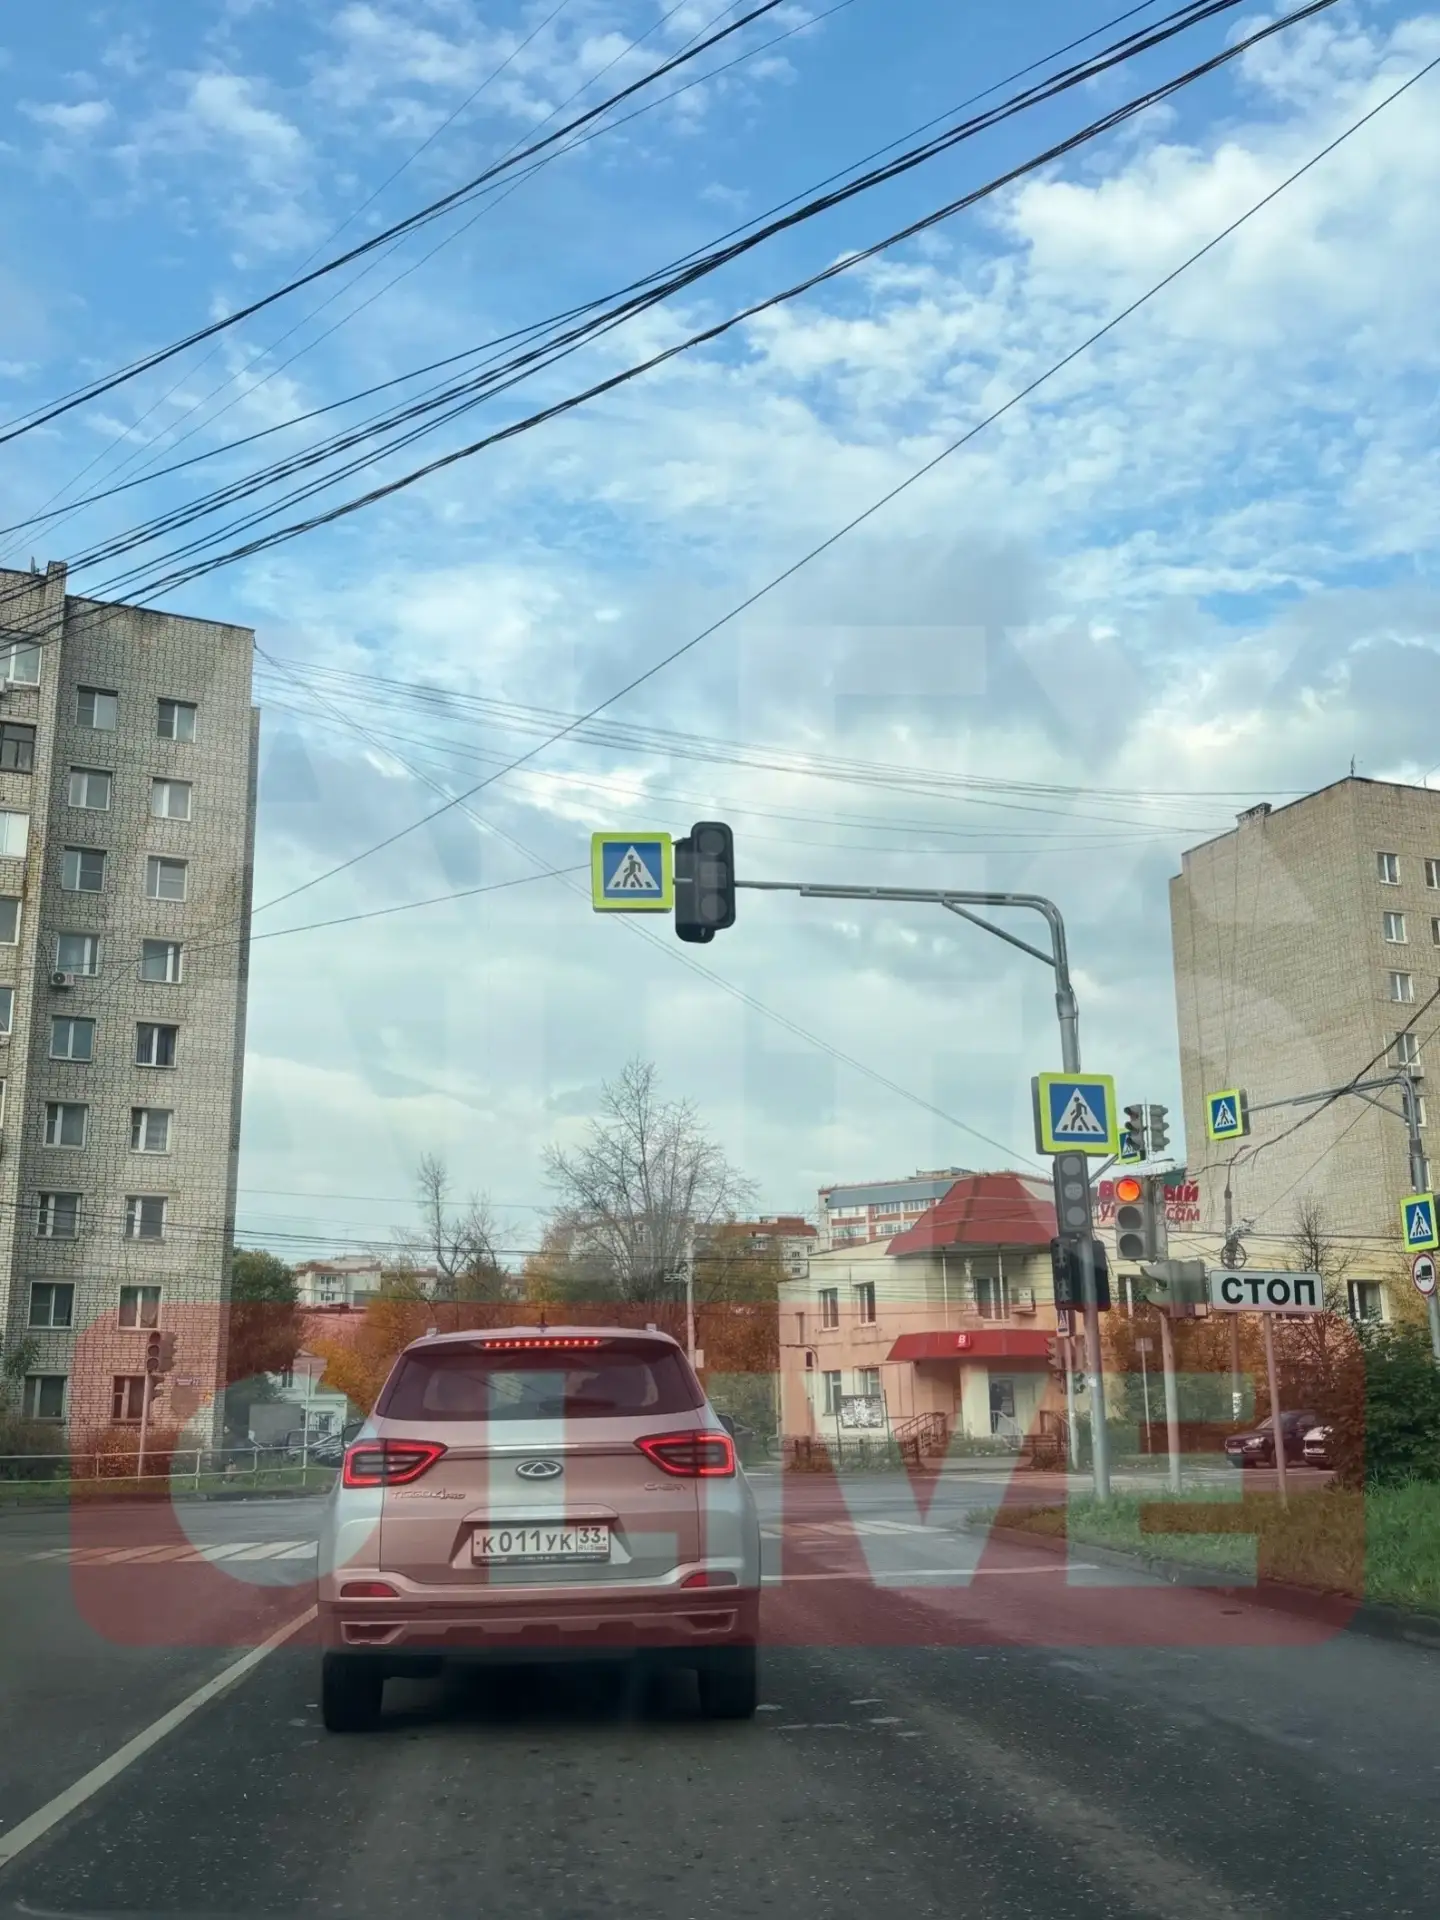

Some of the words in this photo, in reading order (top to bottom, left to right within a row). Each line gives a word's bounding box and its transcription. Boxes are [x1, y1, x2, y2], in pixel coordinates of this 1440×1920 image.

[1221, 1276, 1316, 1307] СТОП
[482, 1530, 573, 1553] К011УК
[579, 1527, 602, 1544] 33
